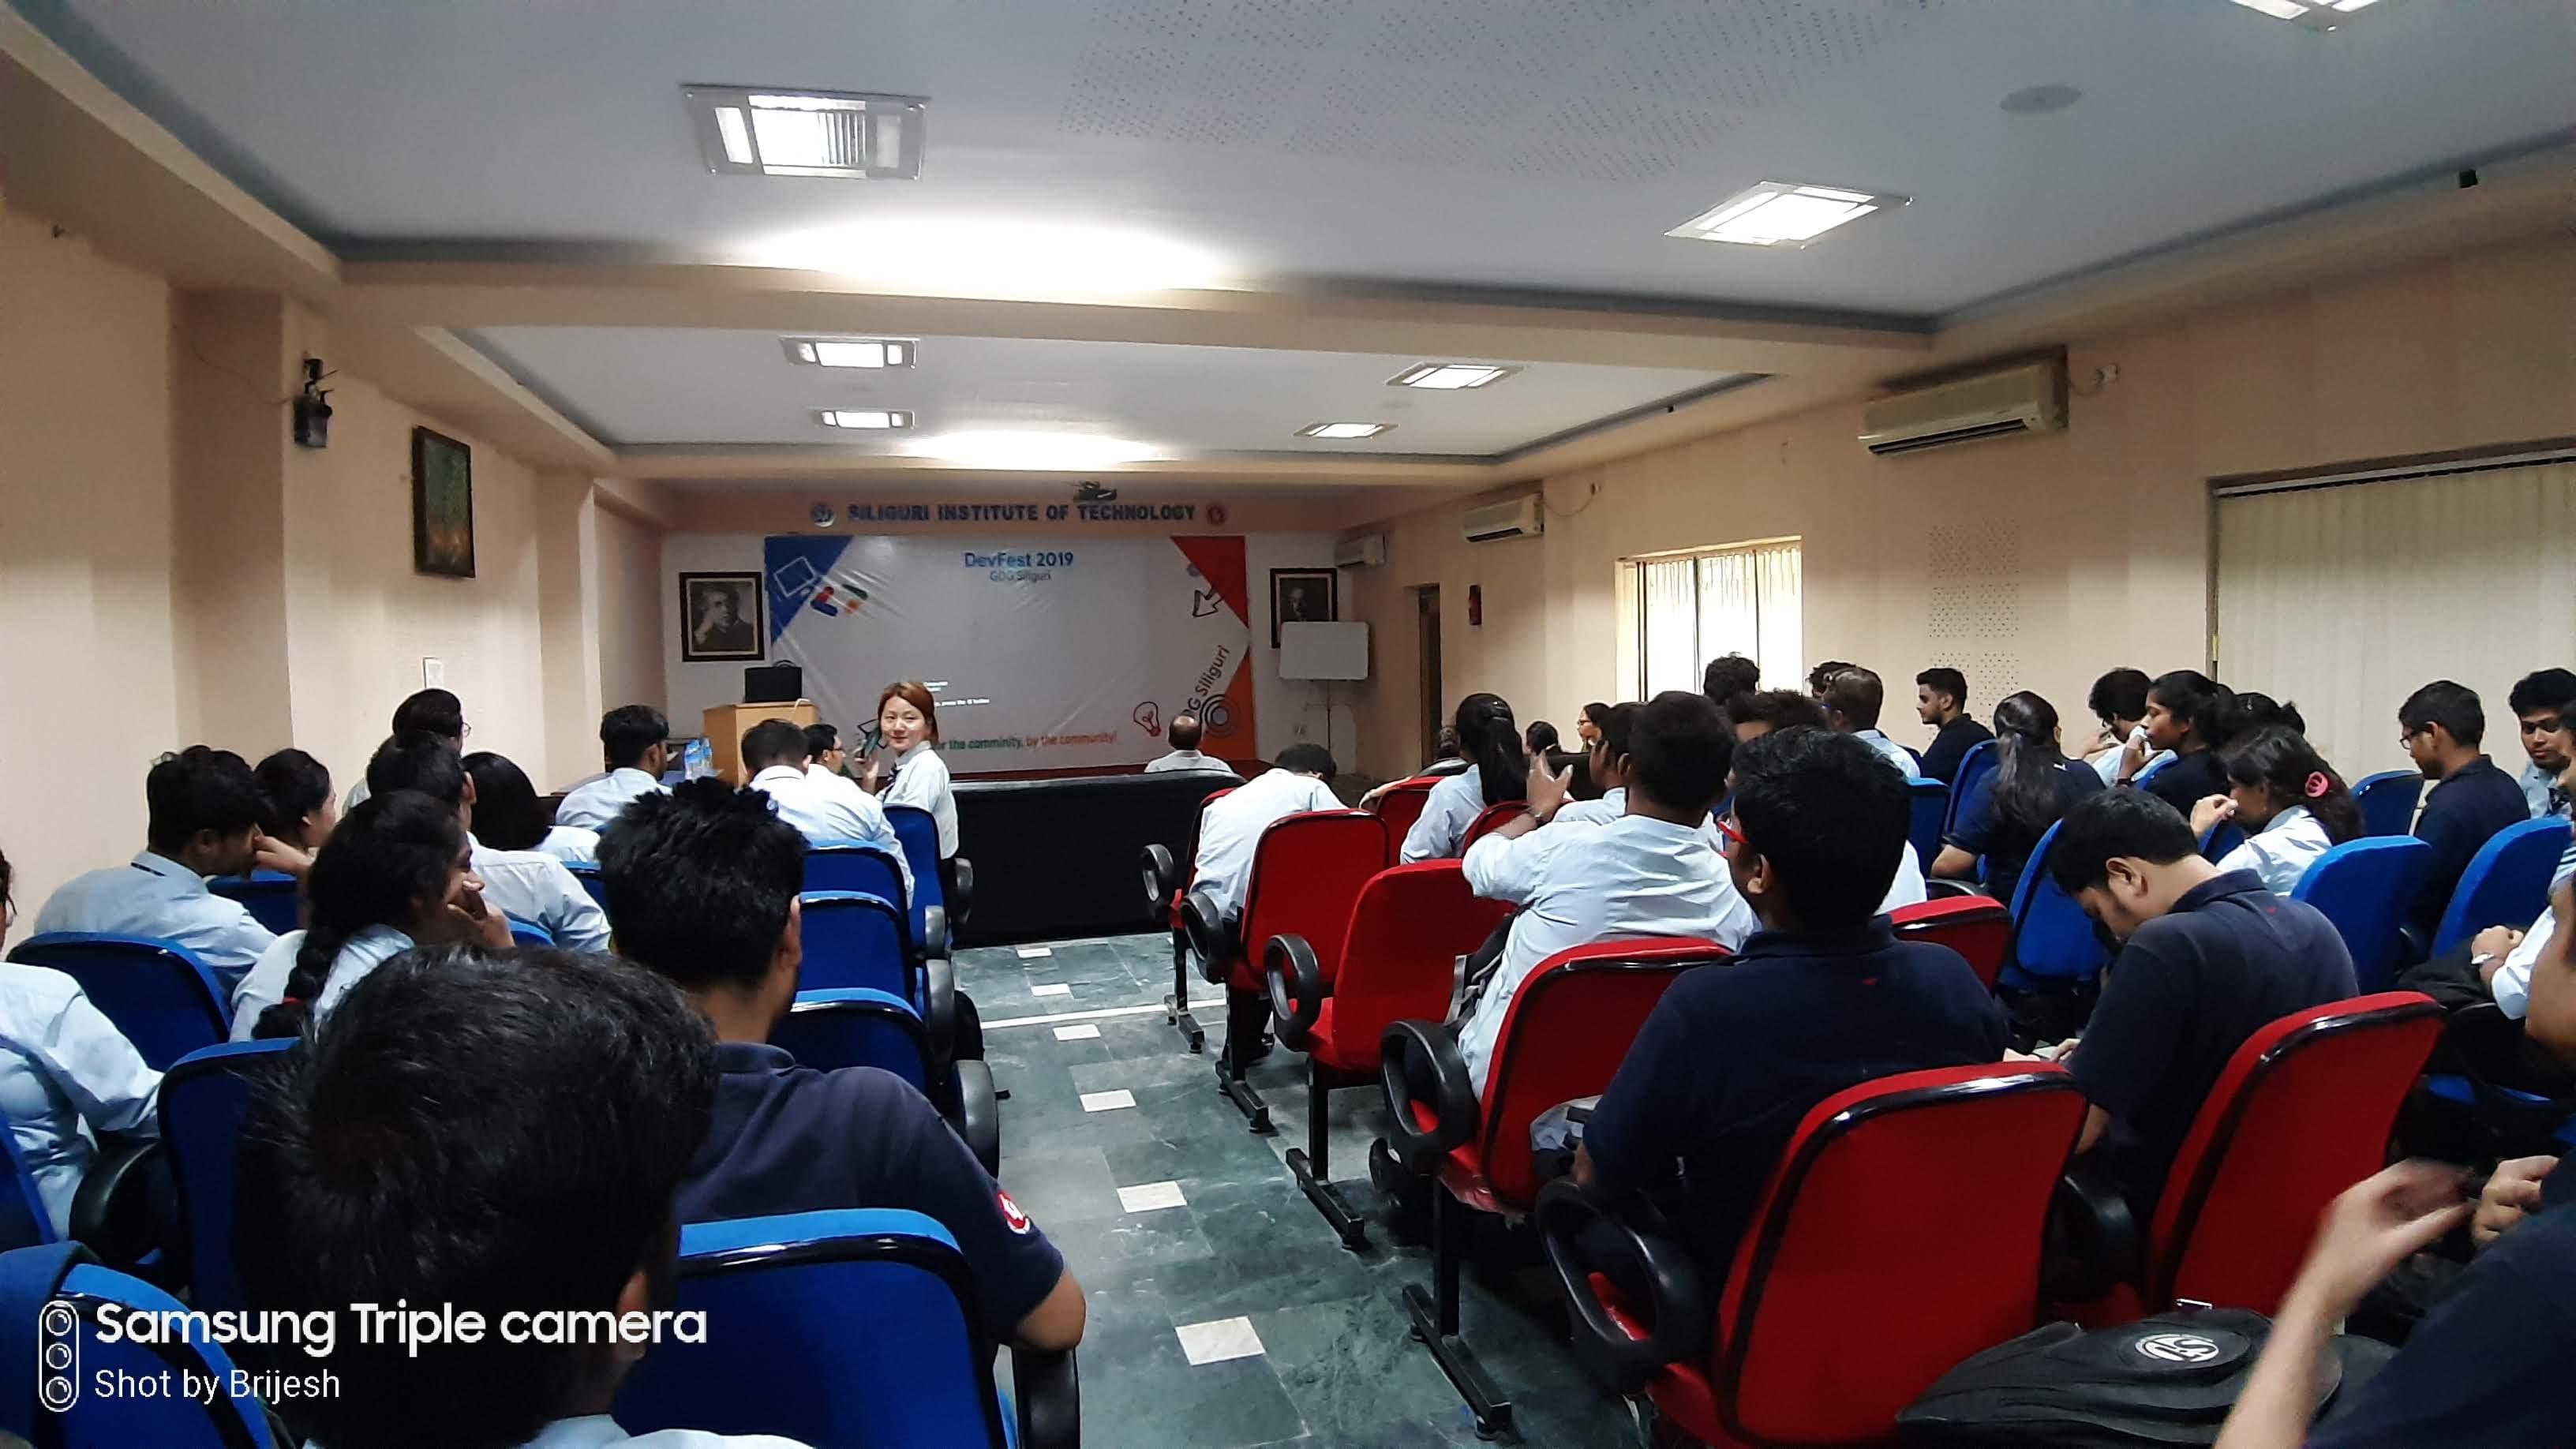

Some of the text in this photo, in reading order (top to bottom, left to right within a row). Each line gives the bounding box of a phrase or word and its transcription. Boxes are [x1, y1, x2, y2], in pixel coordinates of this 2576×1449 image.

[848, 504, 1196, 521] SILIGURI INSTITUTE OF TECHNOLOGY
[964, 552, 1074, 567] DevFest 2019
[1195, 644, 1230, 696] Siliguri
[949, 739, 966, 750] the
[1025, 736, 1039, 749] by
[1040, 734, 1058, 747] the
